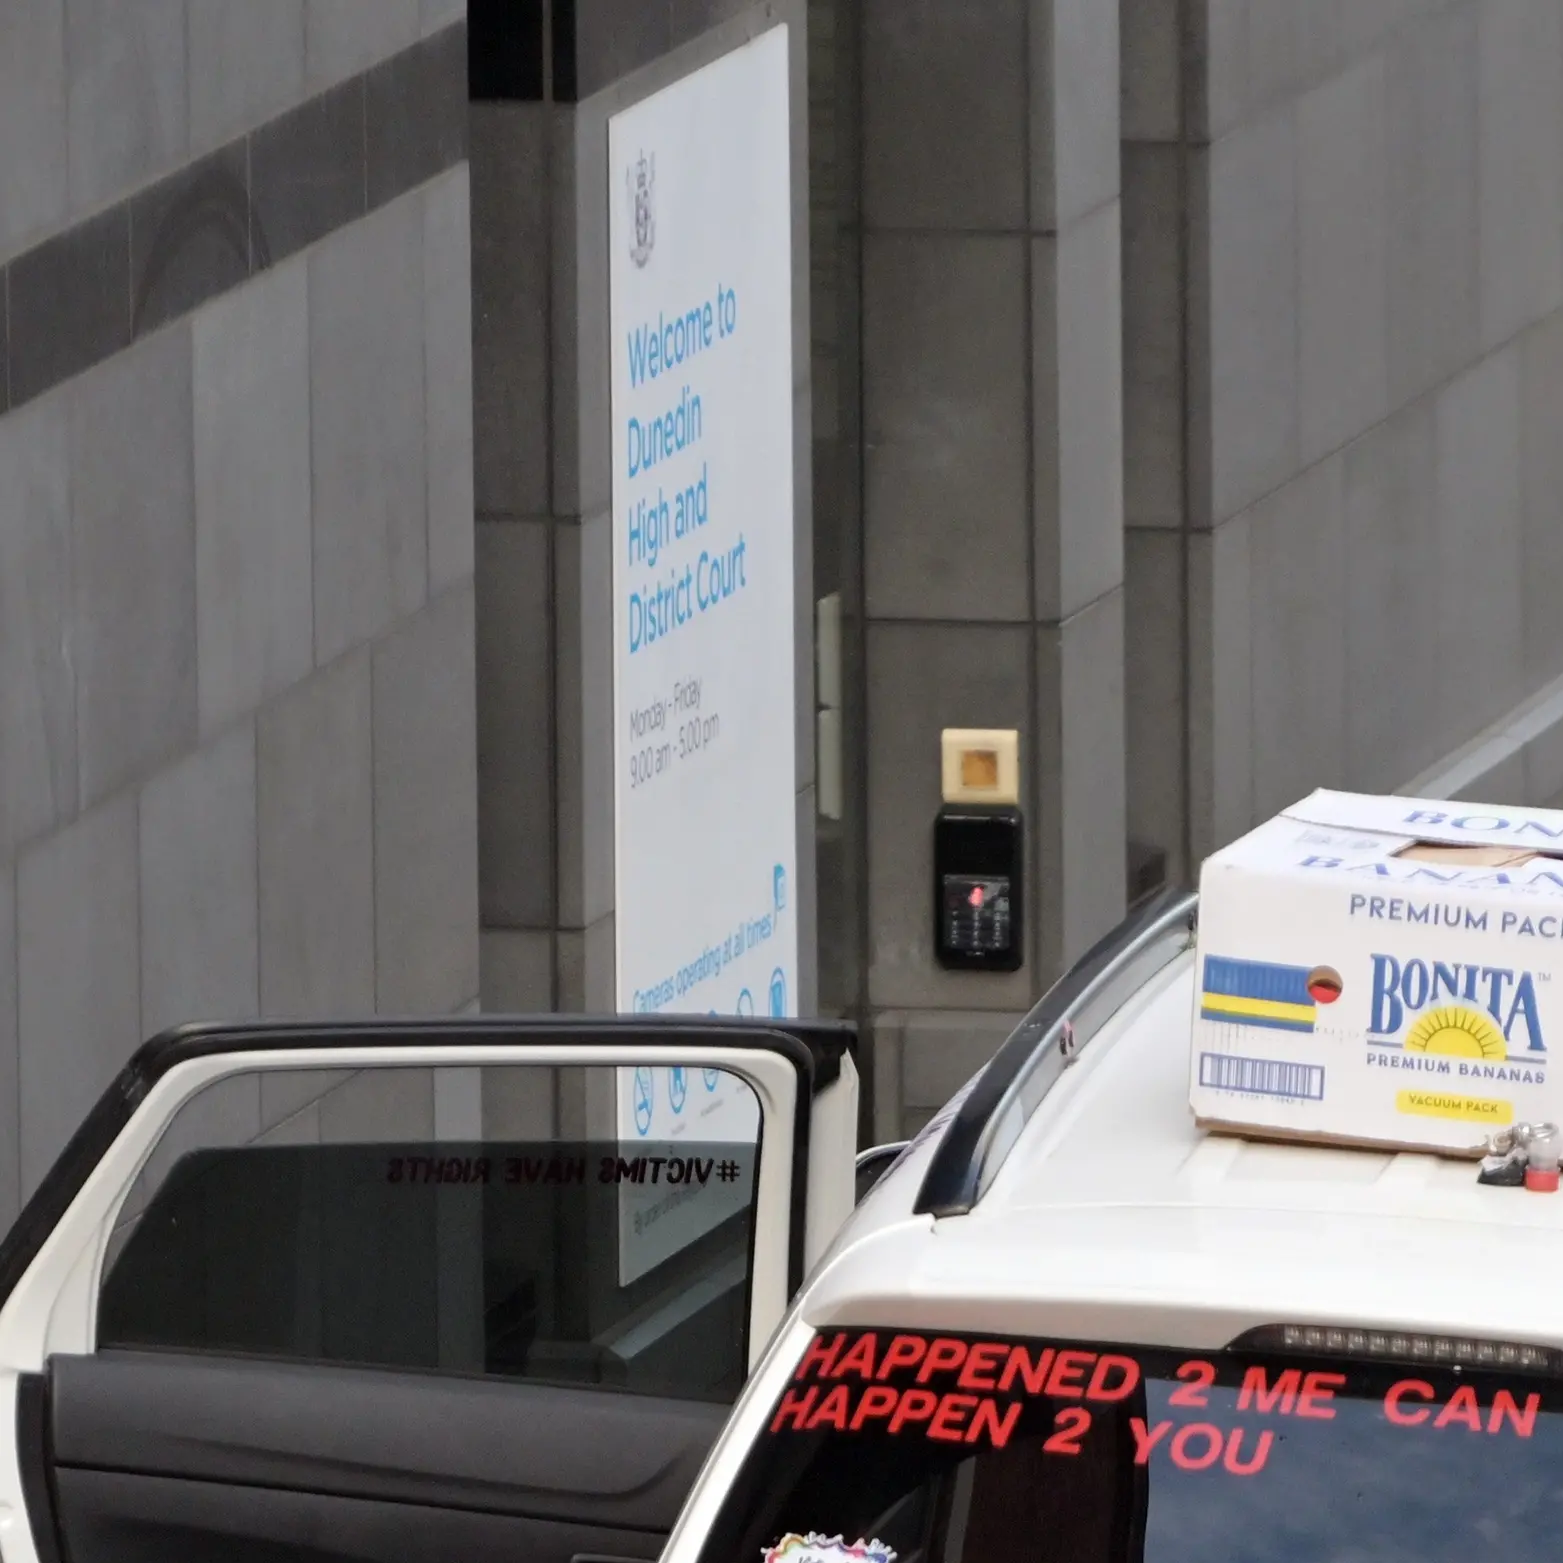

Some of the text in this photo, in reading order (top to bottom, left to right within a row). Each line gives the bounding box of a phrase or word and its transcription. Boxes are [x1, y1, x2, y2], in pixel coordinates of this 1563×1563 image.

[628, 283, 736, 388] Welcome to
[628, 386, 702, 478] Dunedin
[628, 462, 708, 568] High and
[629, 533, 747, 654] District Court
[630, 695, 666, 742] Monday
[674, 675, 702, 716] Friday
[655, 743, 671, 775] am
[703, 712, 720, 751] pm
[676, 944, 722, 996] operating
[723, 931, 733, 966] at
[734, 921, 746, 958] all
[746, 912, 772, 950] times
[1349, 893, 1488, 932] PREMIUM
[1366, 952, 1548, 1053] BONITA
[1366, 1052, 1546, 1085] PREMIUM BANANAS
[1408, 1094, 1499, 1114] VACUUM PACK
[769, 1385, 1275, 1477] HAPPEN 2 YOU
[796, 1332, 1541, 1438] HAPPENED 2 ME CAN
